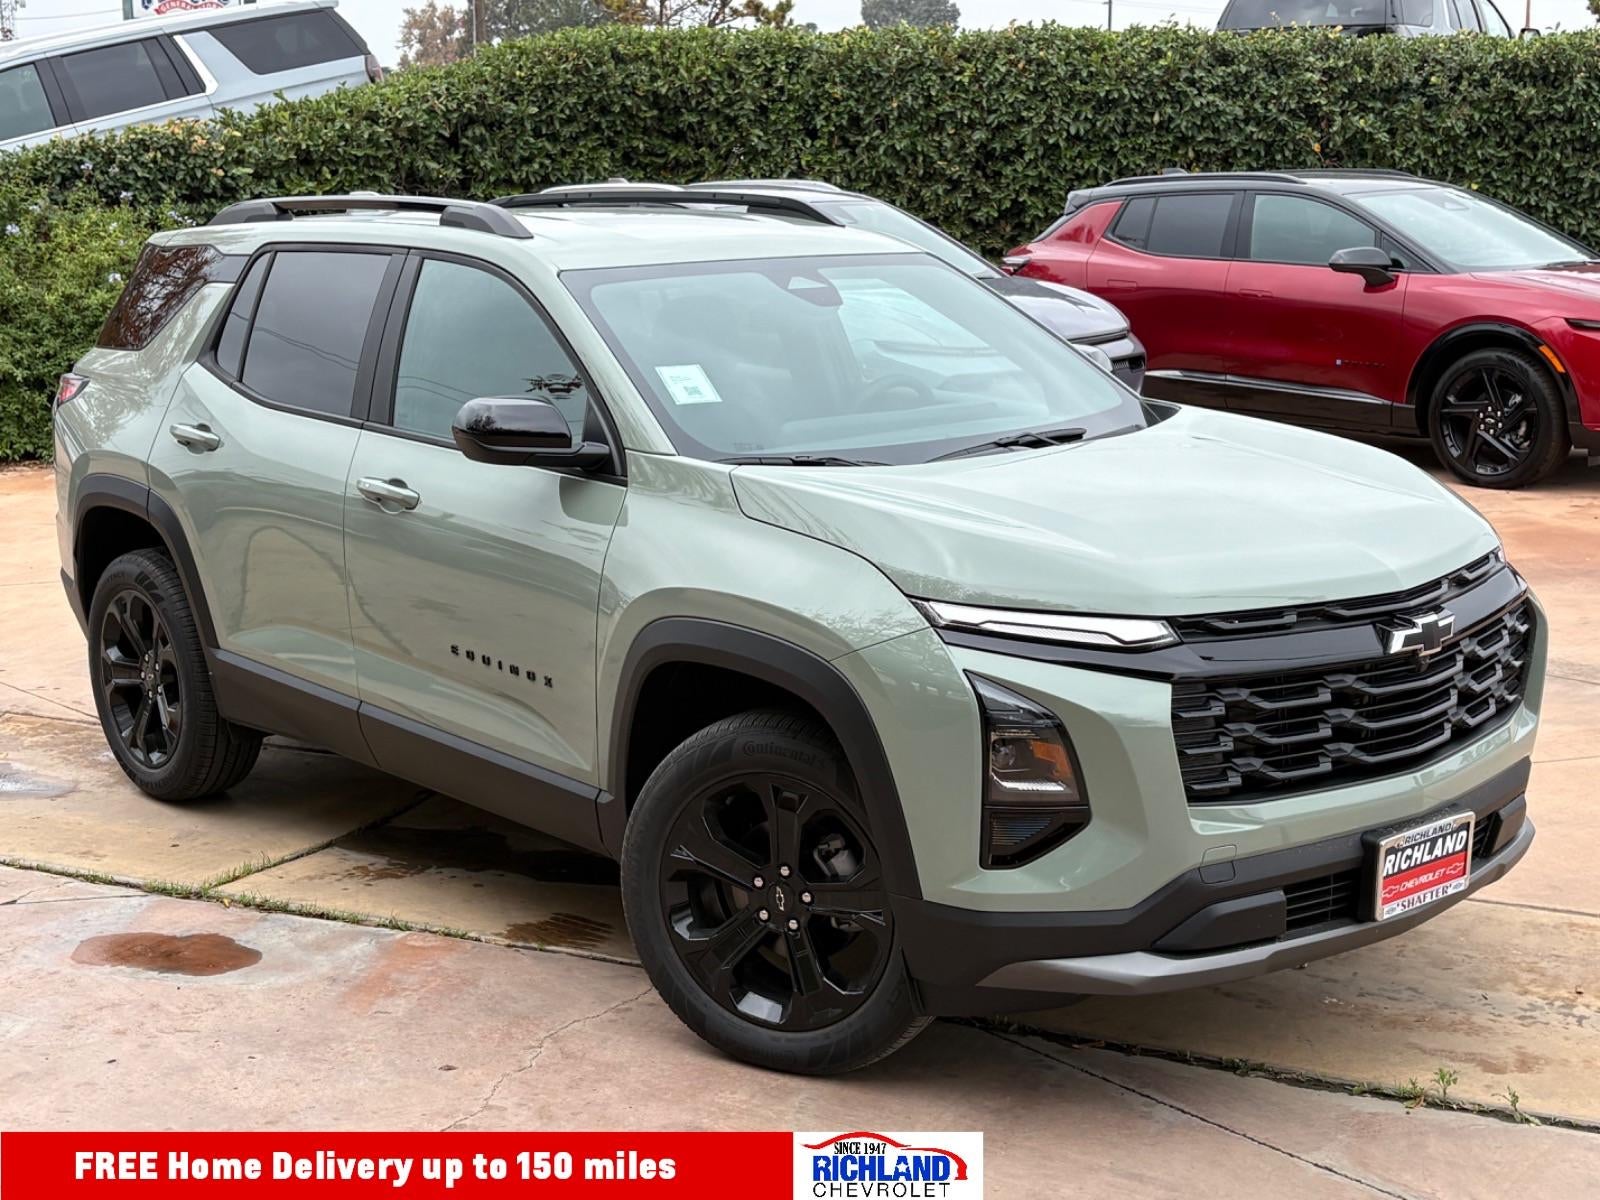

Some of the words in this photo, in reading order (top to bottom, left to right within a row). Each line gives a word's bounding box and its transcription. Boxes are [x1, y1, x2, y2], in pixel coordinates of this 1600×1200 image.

[450, 644, 553, 688] EQUINOX
[1405, 822, 1452, 844] RICHLAND
[1384, 831, 1467, 876] RICHLAND
[1400, 868, 1446, 892] CHEVROLET
